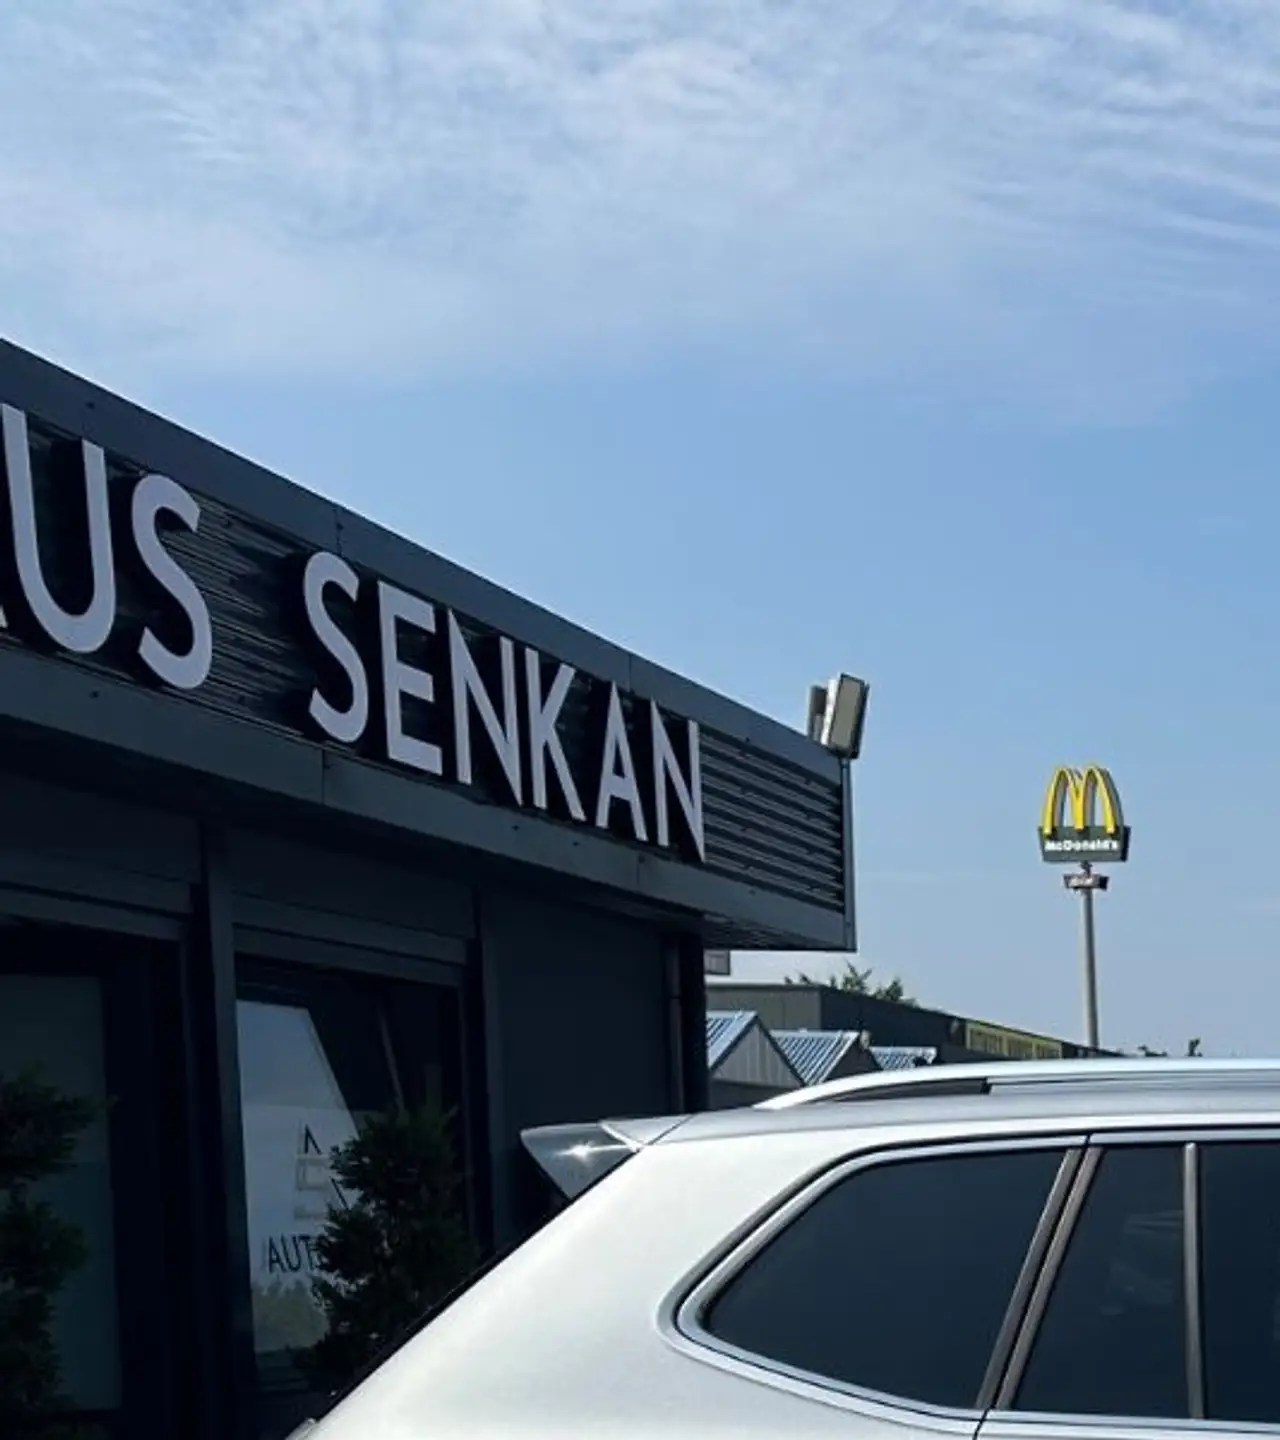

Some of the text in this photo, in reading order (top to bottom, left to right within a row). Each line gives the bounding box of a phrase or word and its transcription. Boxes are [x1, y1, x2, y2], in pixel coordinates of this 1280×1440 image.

[0, 403, 705, 862] US SENKAN
[1045, 839, 1118, 850] McDonald's
